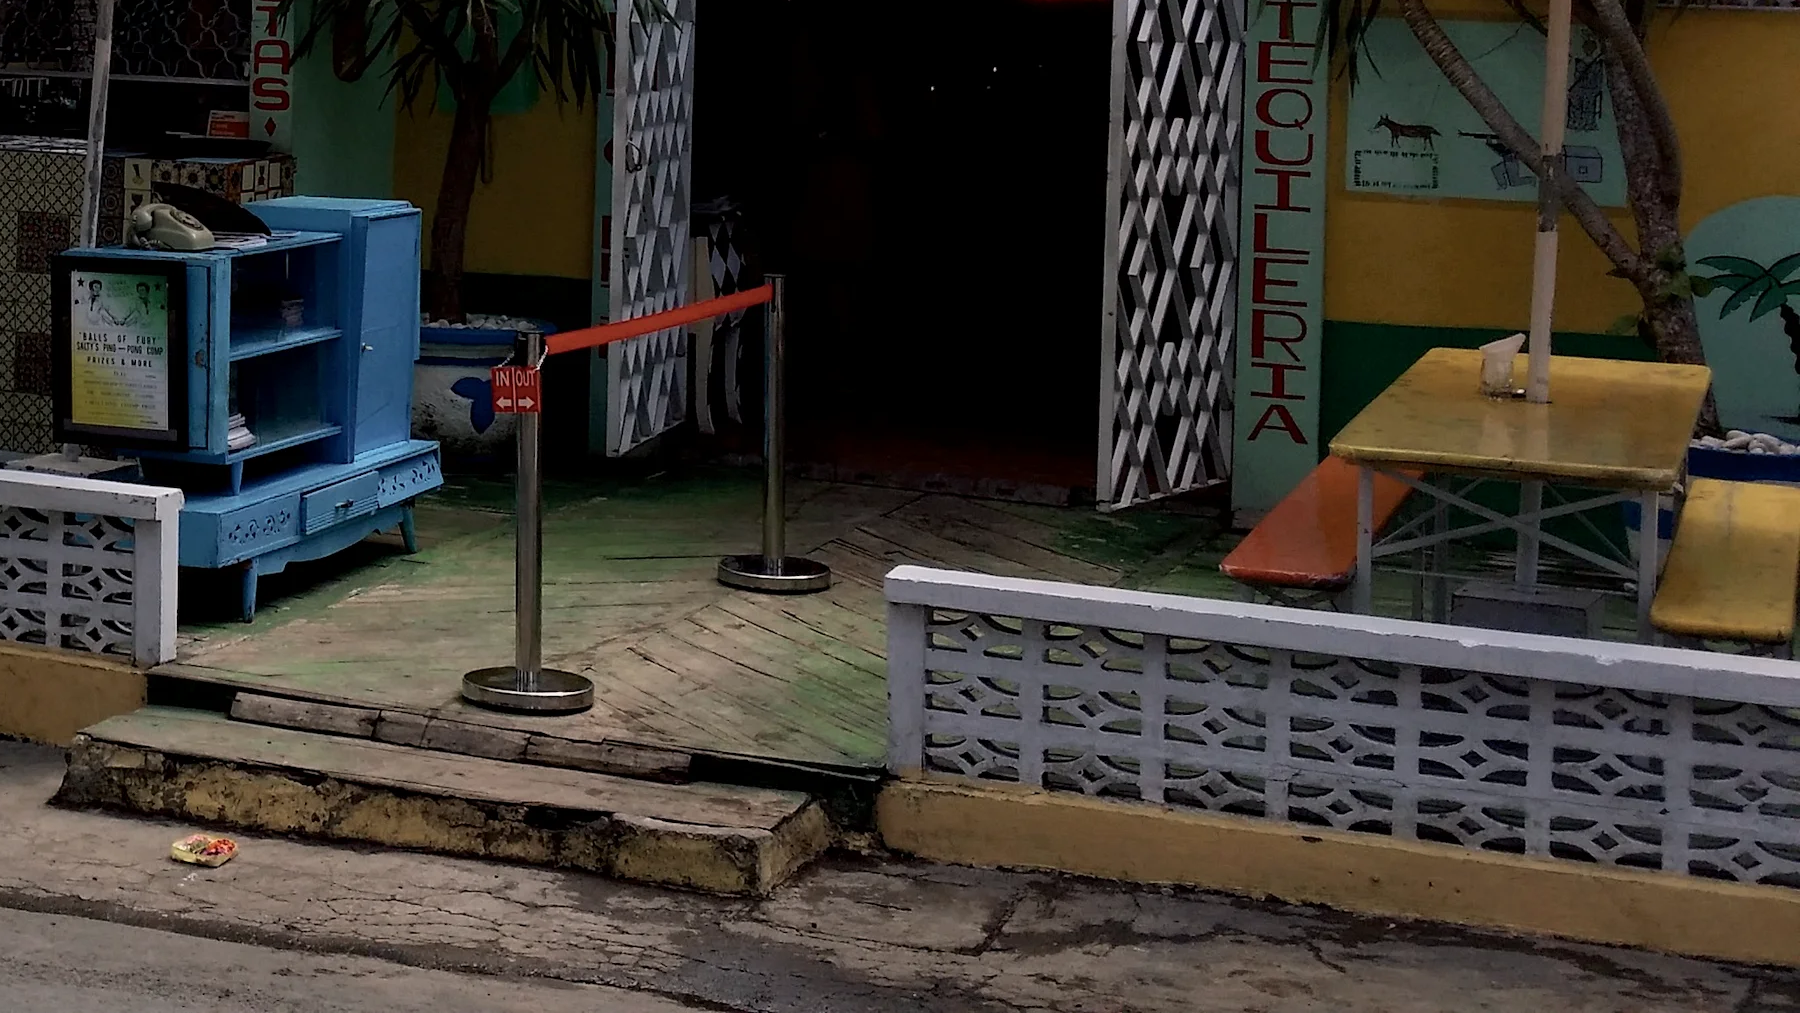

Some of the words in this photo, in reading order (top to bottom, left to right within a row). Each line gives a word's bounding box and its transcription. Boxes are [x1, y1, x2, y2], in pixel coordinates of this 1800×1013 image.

[1247, 0, 1318, 445] TEQUILERIA
[117, 334, 126, 343] OF
[146, 345, 164, 356] COMP
[87, 356, 114, 365] PRIZES
[131, 359, 152, 368] MORE
[496, 370, 510, 387] IN
[515, 369, 536, 387] OUT
